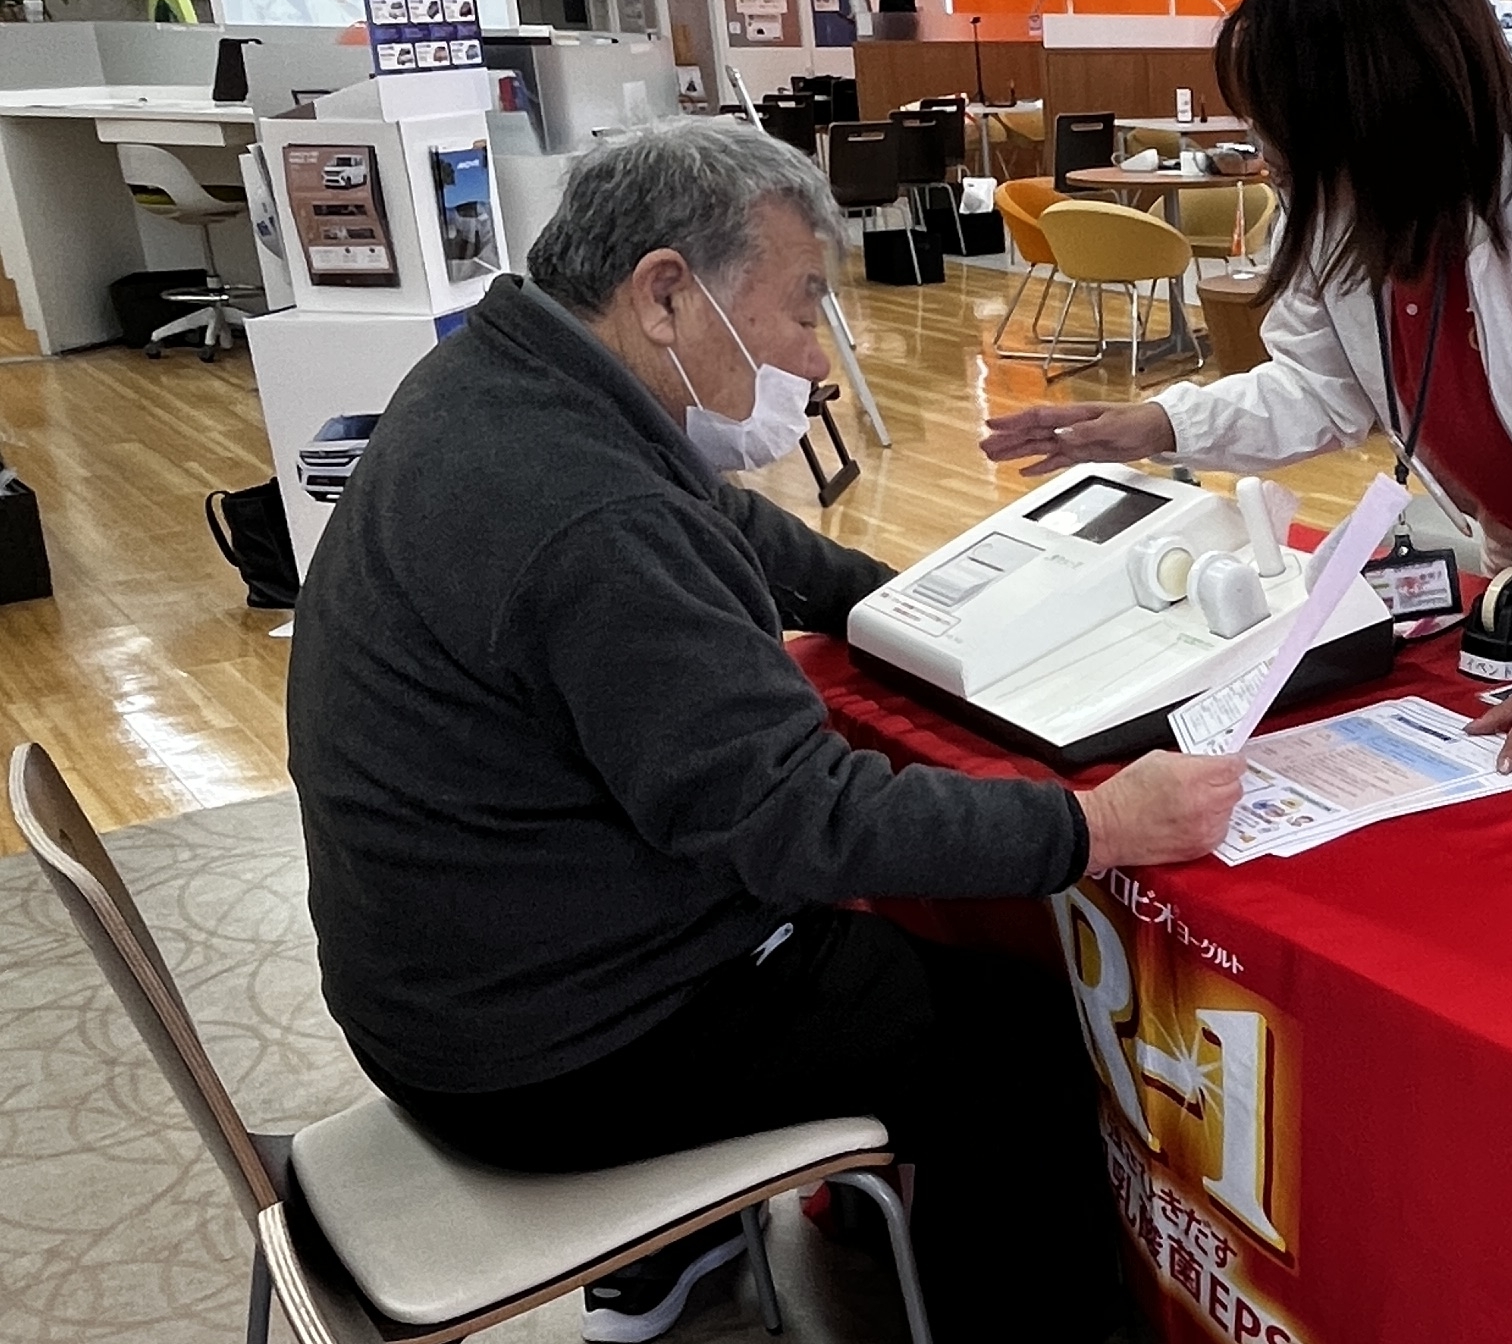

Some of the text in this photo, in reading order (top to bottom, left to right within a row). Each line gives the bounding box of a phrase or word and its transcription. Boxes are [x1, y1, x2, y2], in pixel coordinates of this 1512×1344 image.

[1466, 658, 1512, 679] イベント
[1090, 867, 1245, 975] ロビオヨーグルト
